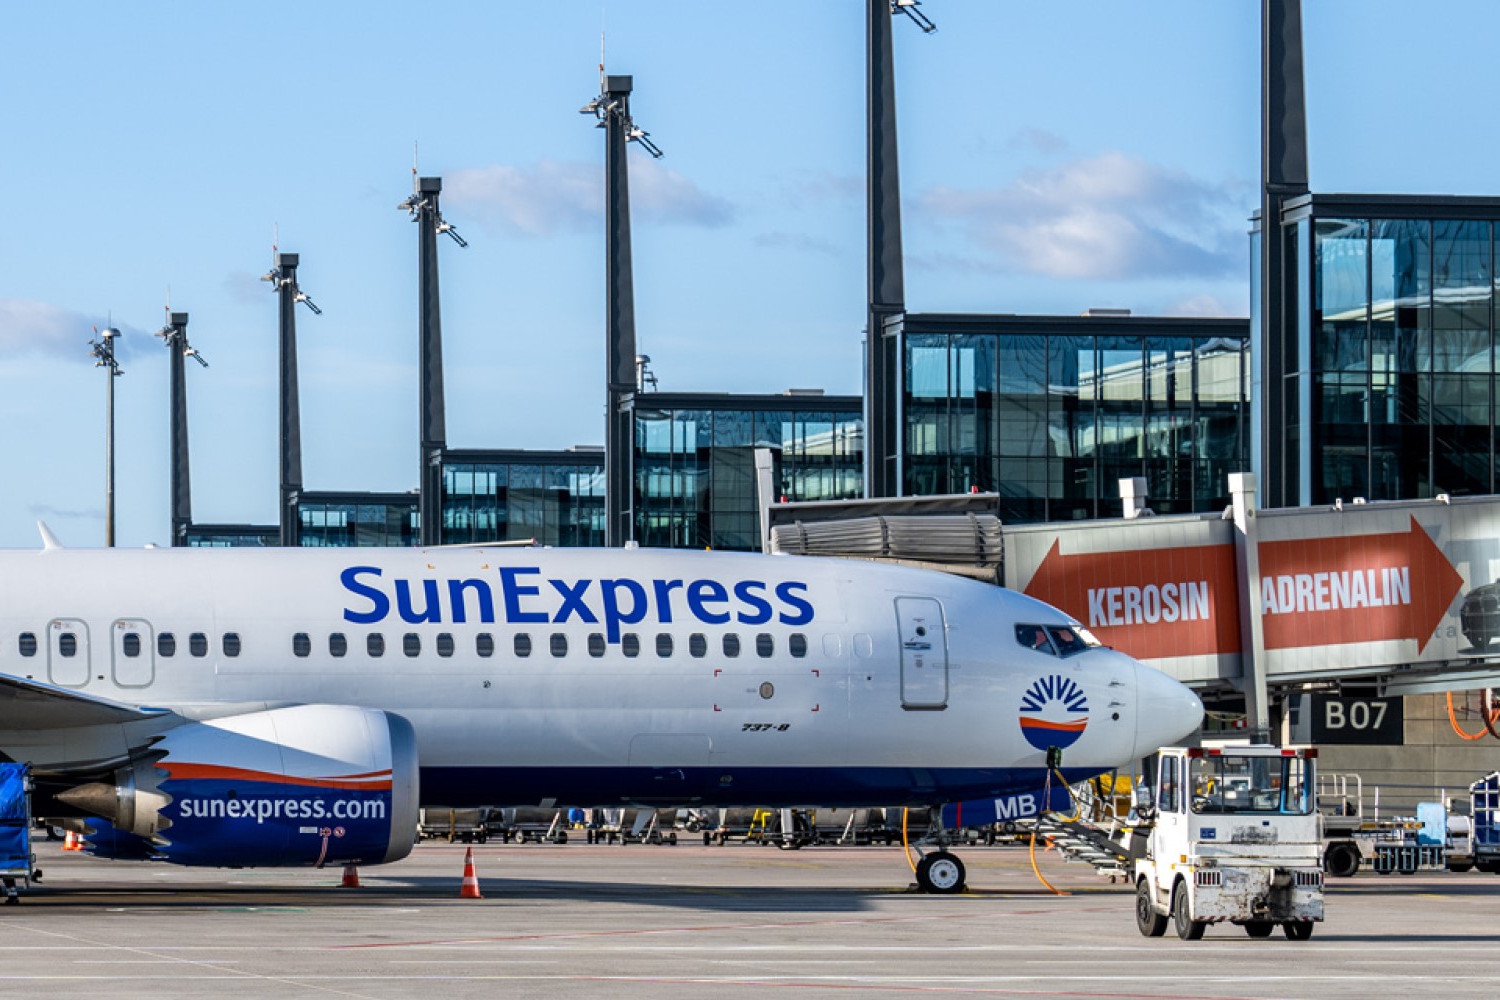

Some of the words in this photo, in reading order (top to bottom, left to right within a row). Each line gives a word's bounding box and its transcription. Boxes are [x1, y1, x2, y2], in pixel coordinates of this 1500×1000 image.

[1088, 581, 1210, 628] KEROSIN
[1261, 566, 1411, 615] ADRENALIN
[340, 566, 815, 644] SunExpress
[741, 723, 790, 732] 737-8
[1325, 701, 1388, 729] B07
[180, 799, 385, 824] sunexpress.com
[994, 794, 1036, 820] MB
